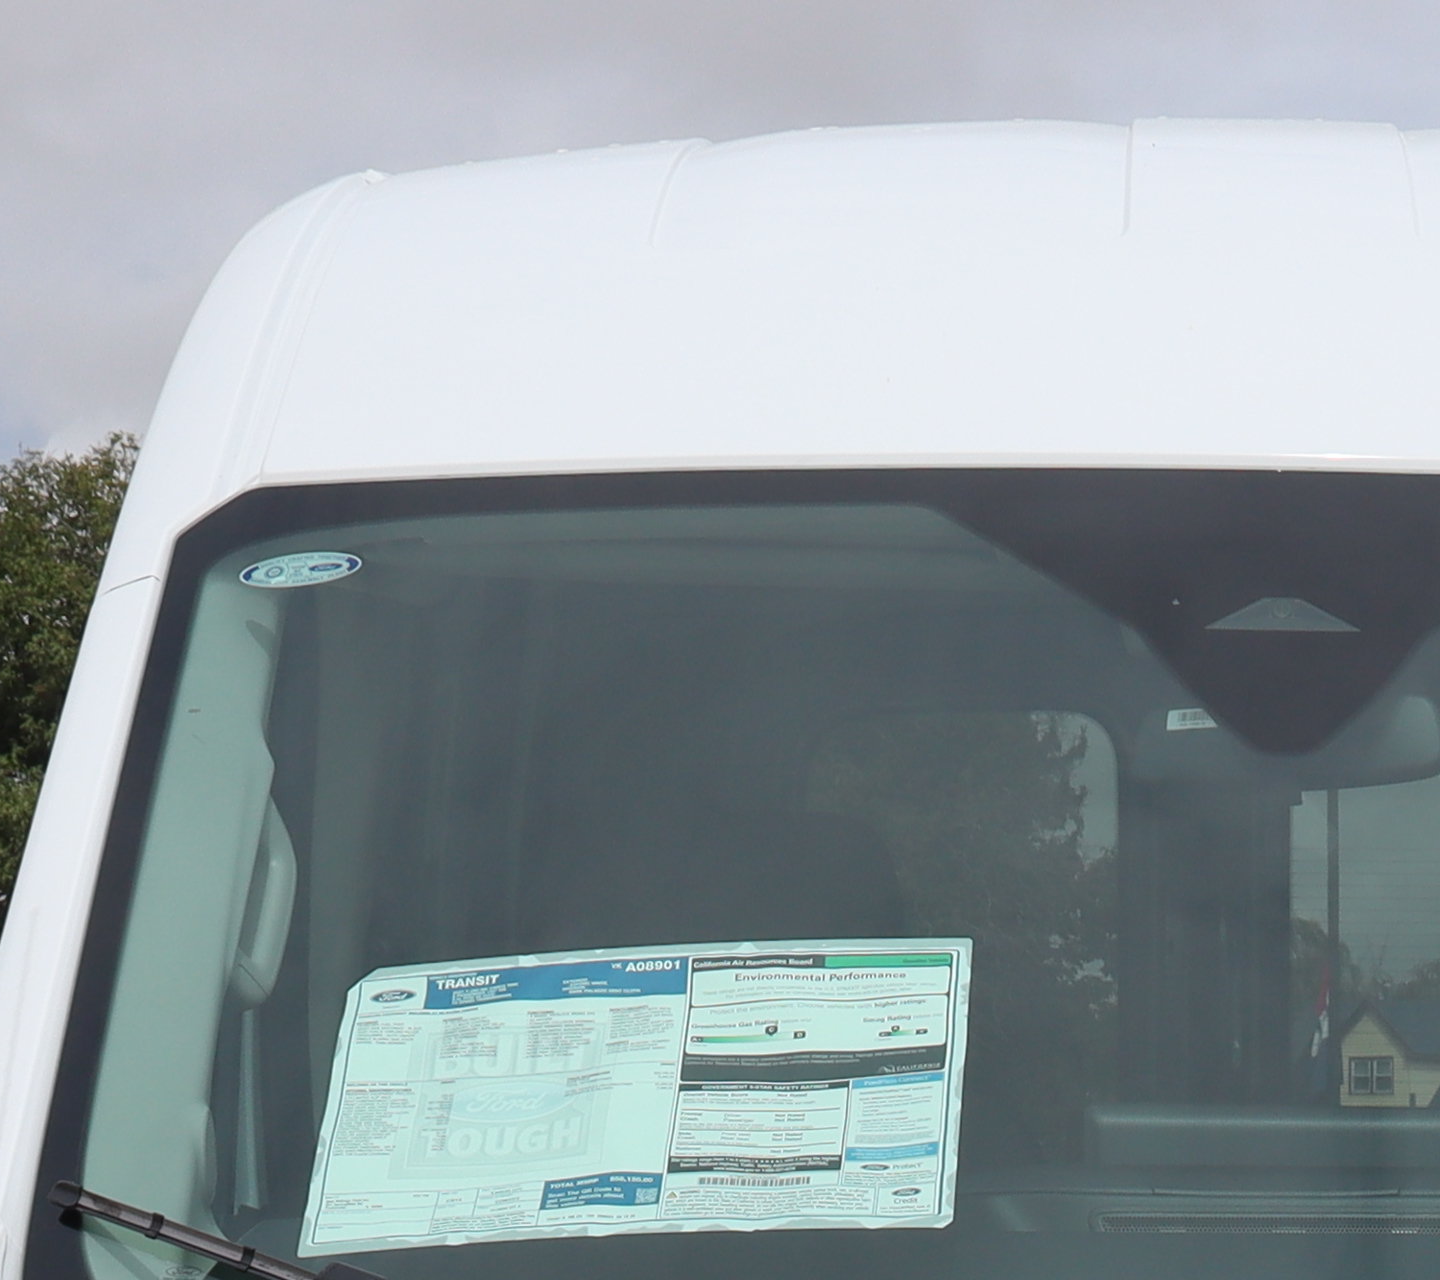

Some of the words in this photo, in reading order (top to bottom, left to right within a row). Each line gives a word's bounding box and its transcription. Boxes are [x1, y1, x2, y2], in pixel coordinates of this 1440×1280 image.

[625, 959, 682, 974] A08901
[693, 959, 731, 969] California
[732, 959, 745, 967] Air
[745, 958, 787, 967] Resources
[788, 957, 813, 966] Board
[435, 974, 500, 991] TRANSIT
[734, 972, 826, 982] Environmental
[828, 970, 907, 982] Performance
[738, 1020, 754, 1028] Gas
[754, 1018, 779, 1027] Rating
[887, 1013, 912, 1022] Rating
[466, 1088, 545, 1113] Ford
[420, 1116, 584, 1160] TOUGH
